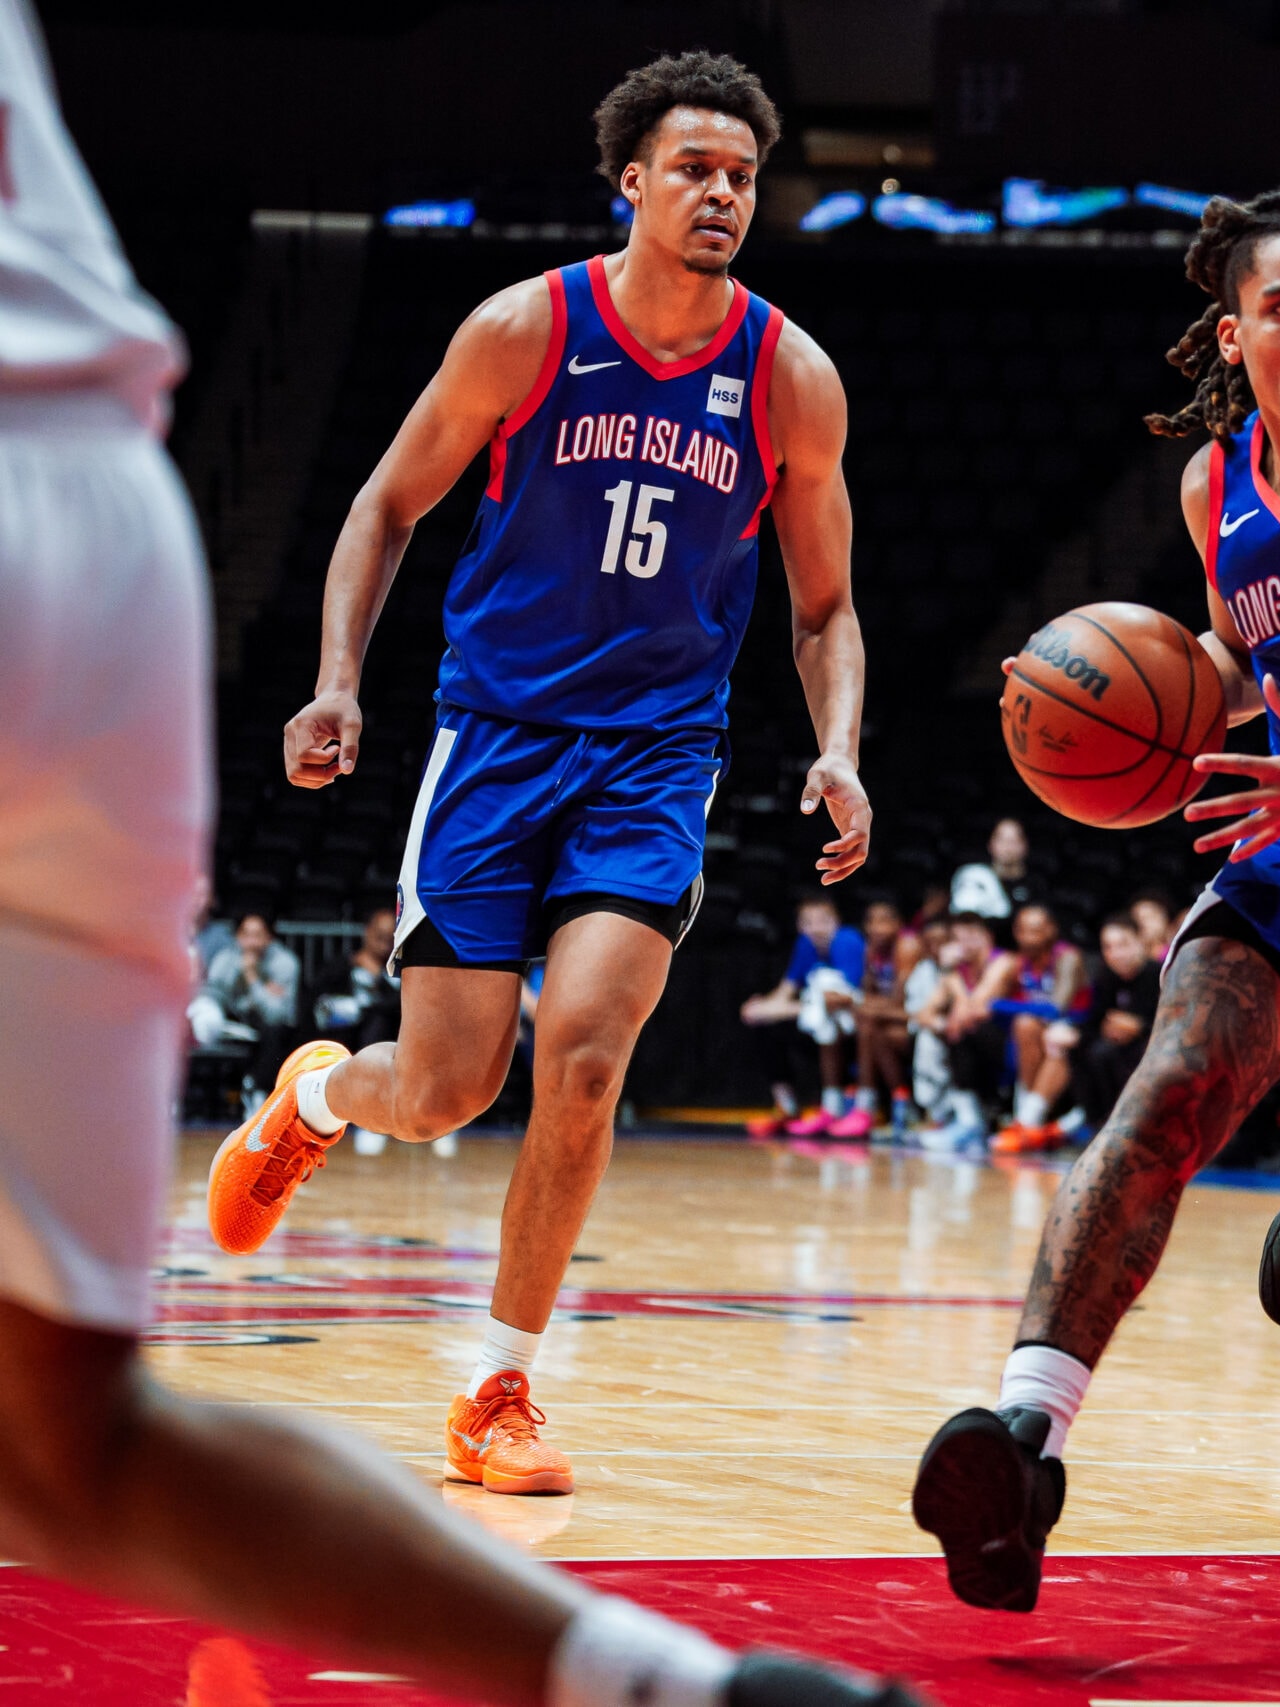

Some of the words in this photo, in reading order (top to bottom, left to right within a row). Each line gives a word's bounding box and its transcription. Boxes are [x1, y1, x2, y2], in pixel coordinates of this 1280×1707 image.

[711, 388, 739, 404] HSS
[555, 414, 636, 466] LONG
[641, 415, 739, 494] ISLAND
[600, 480, 675, 579] 15
